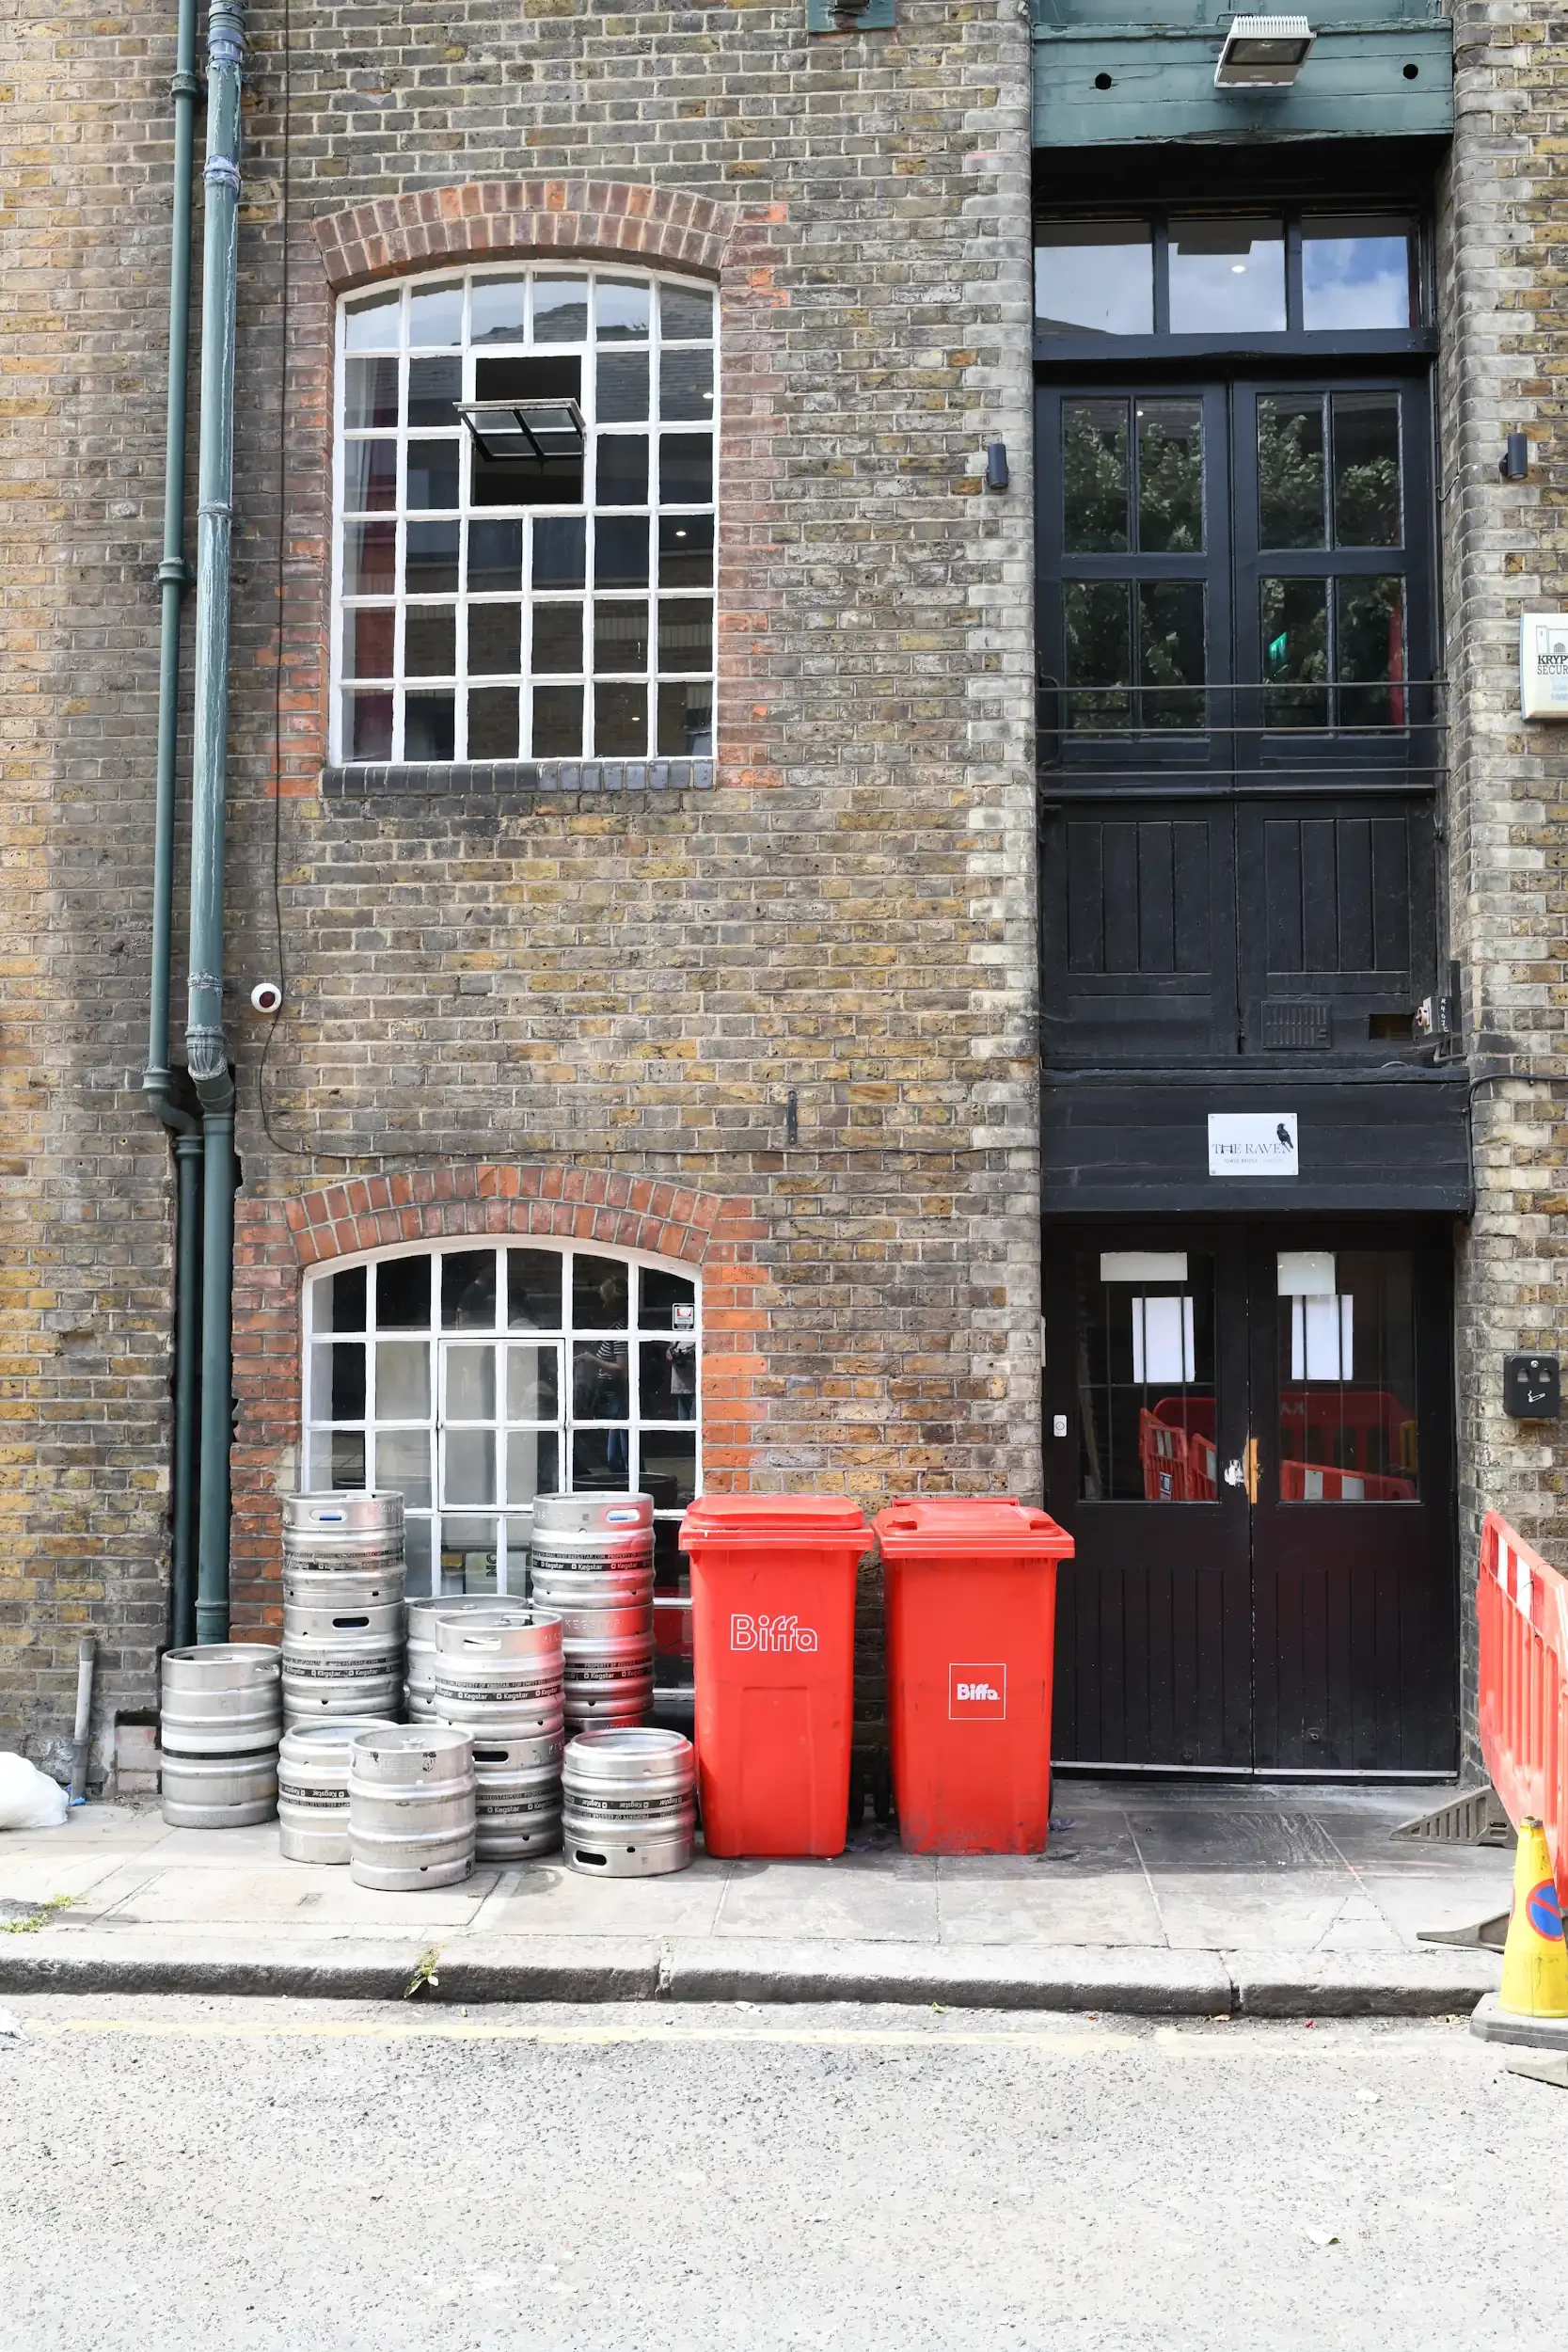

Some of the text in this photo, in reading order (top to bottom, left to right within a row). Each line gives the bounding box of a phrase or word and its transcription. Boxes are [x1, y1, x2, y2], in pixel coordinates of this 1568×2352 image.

[1212, 1143, 1292, 1154] THE RAVEN
[546, 1561, 564, 1570] Kegstar
[578, 1563, 603, 1571] Kegstar
[617, 1562, 638, 1570] Kegstar
[731, 1613, 818, 1652] Biffa
[464, 1692, 488, 1701] Kegstar
[503, 1691, 529, 1700] Kegstar
[541, 1687, 558, 1696] Kegstar
[311, 1789, 338, 1798] Kegstar
[581, 1799, 602, 1808] Kegstar
[619, 1801, 642, 1809] Kegstar
[494, 1805, 520, 1815] Kegstar
